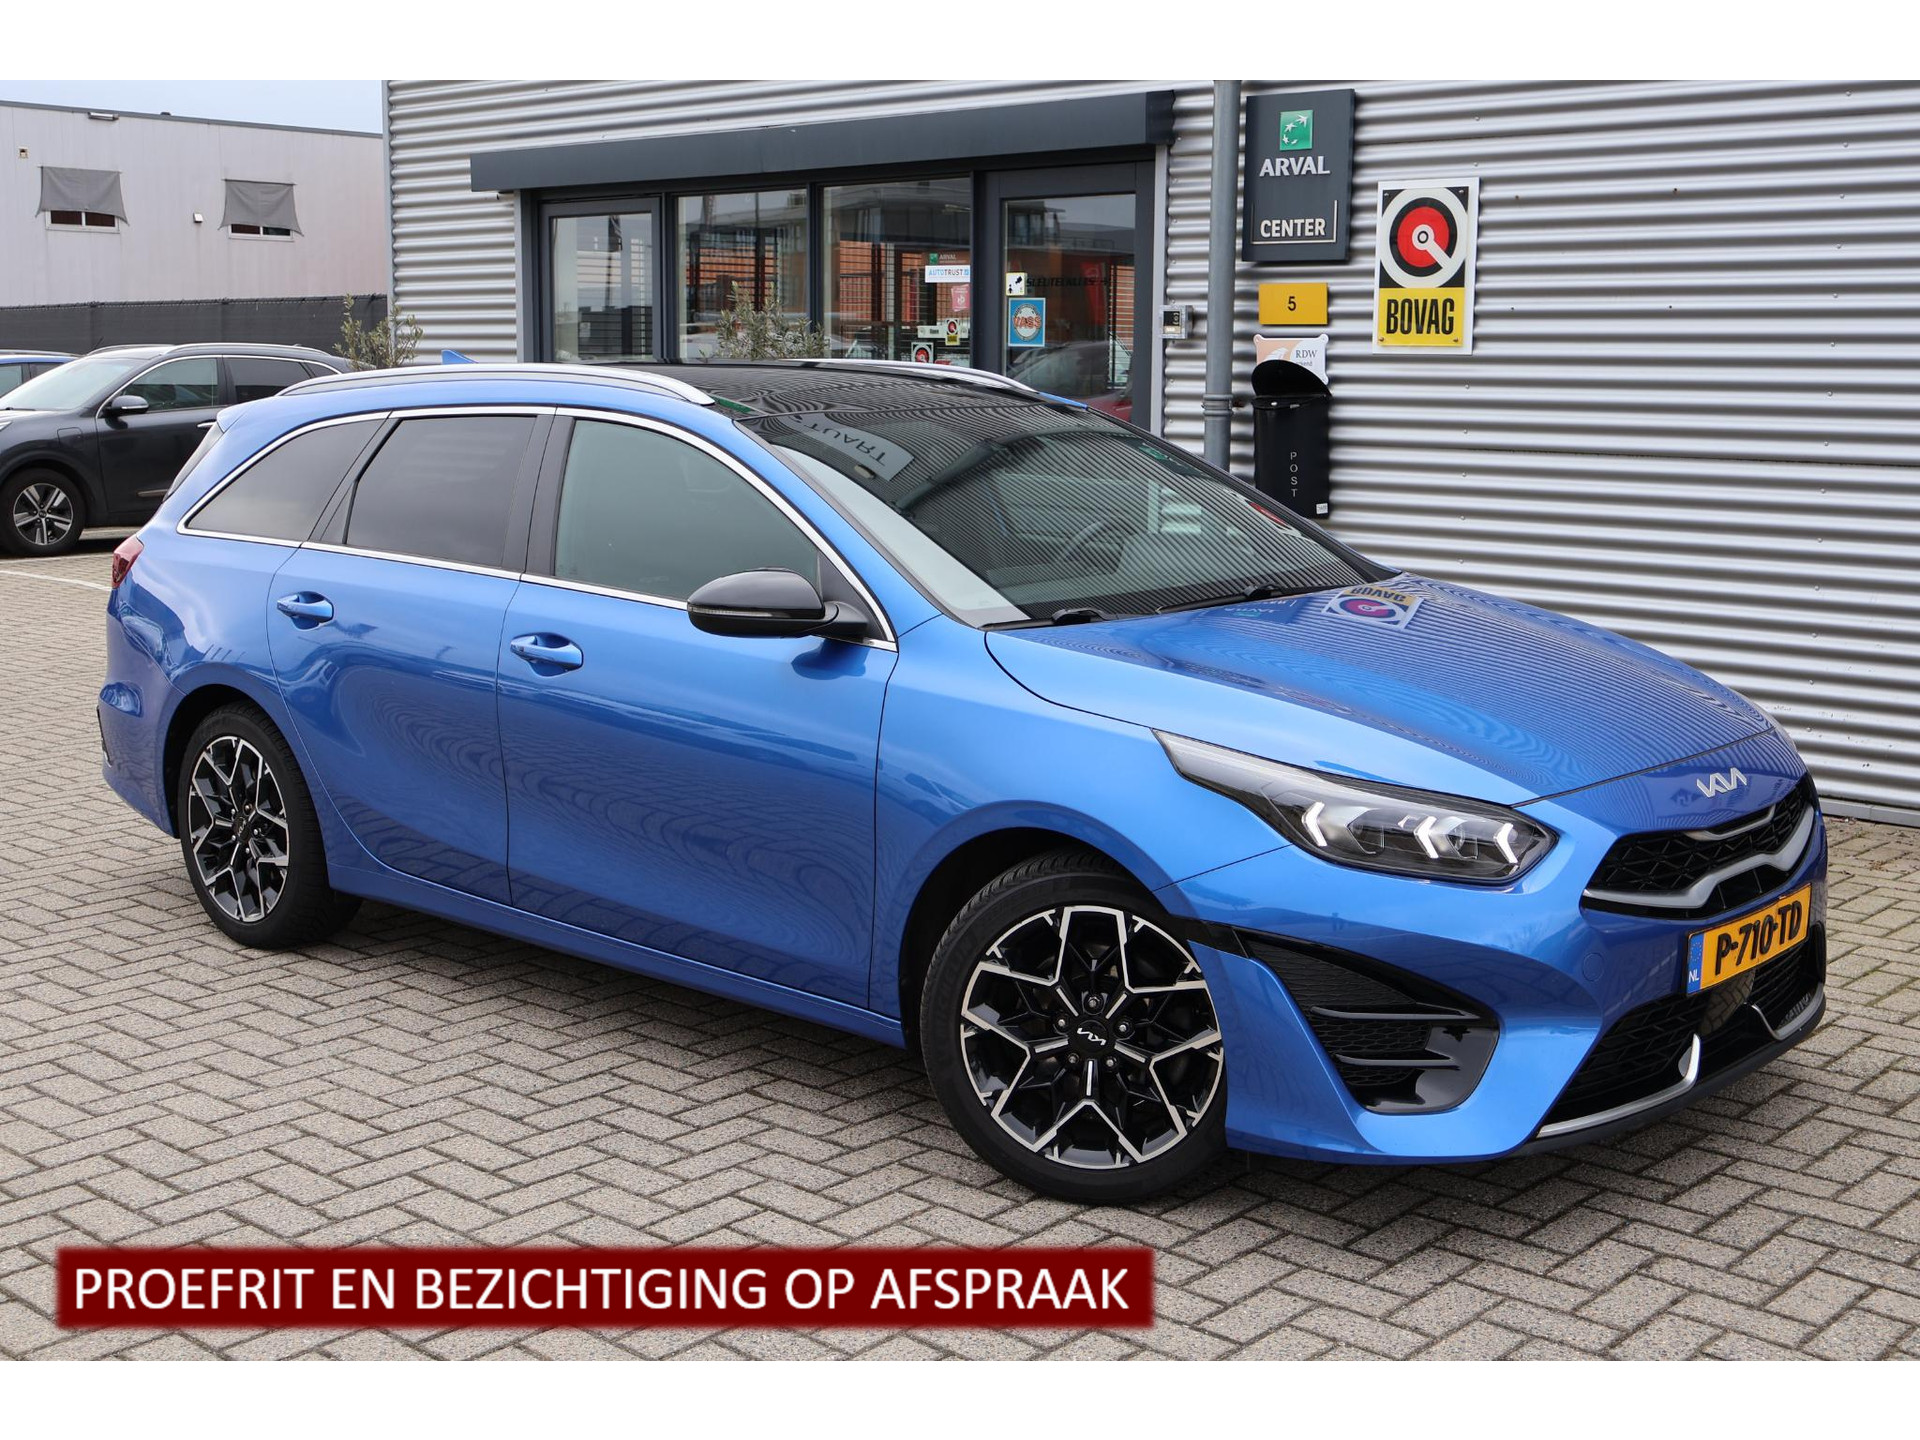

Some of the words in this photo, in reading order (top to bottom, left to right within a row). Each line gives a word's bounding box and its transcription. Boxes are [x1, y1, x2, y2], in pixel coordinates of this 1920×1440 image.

[1259, 156, 1331, 177] ARVAL
[1260, 218, 1326, 238] CENTER
[929, 268, 963, 276] AUTOTRUST
[1287, 296, 1297, 311] 5
[1386, 298, 1455, 335] BOVAG
[1295, 350, 1317, 359] RDW
[1290, 451, 1299, 498] POST
[1715, 900, 1802, 976] P-710-TD
[1688, 970, 1700, 982] NL
